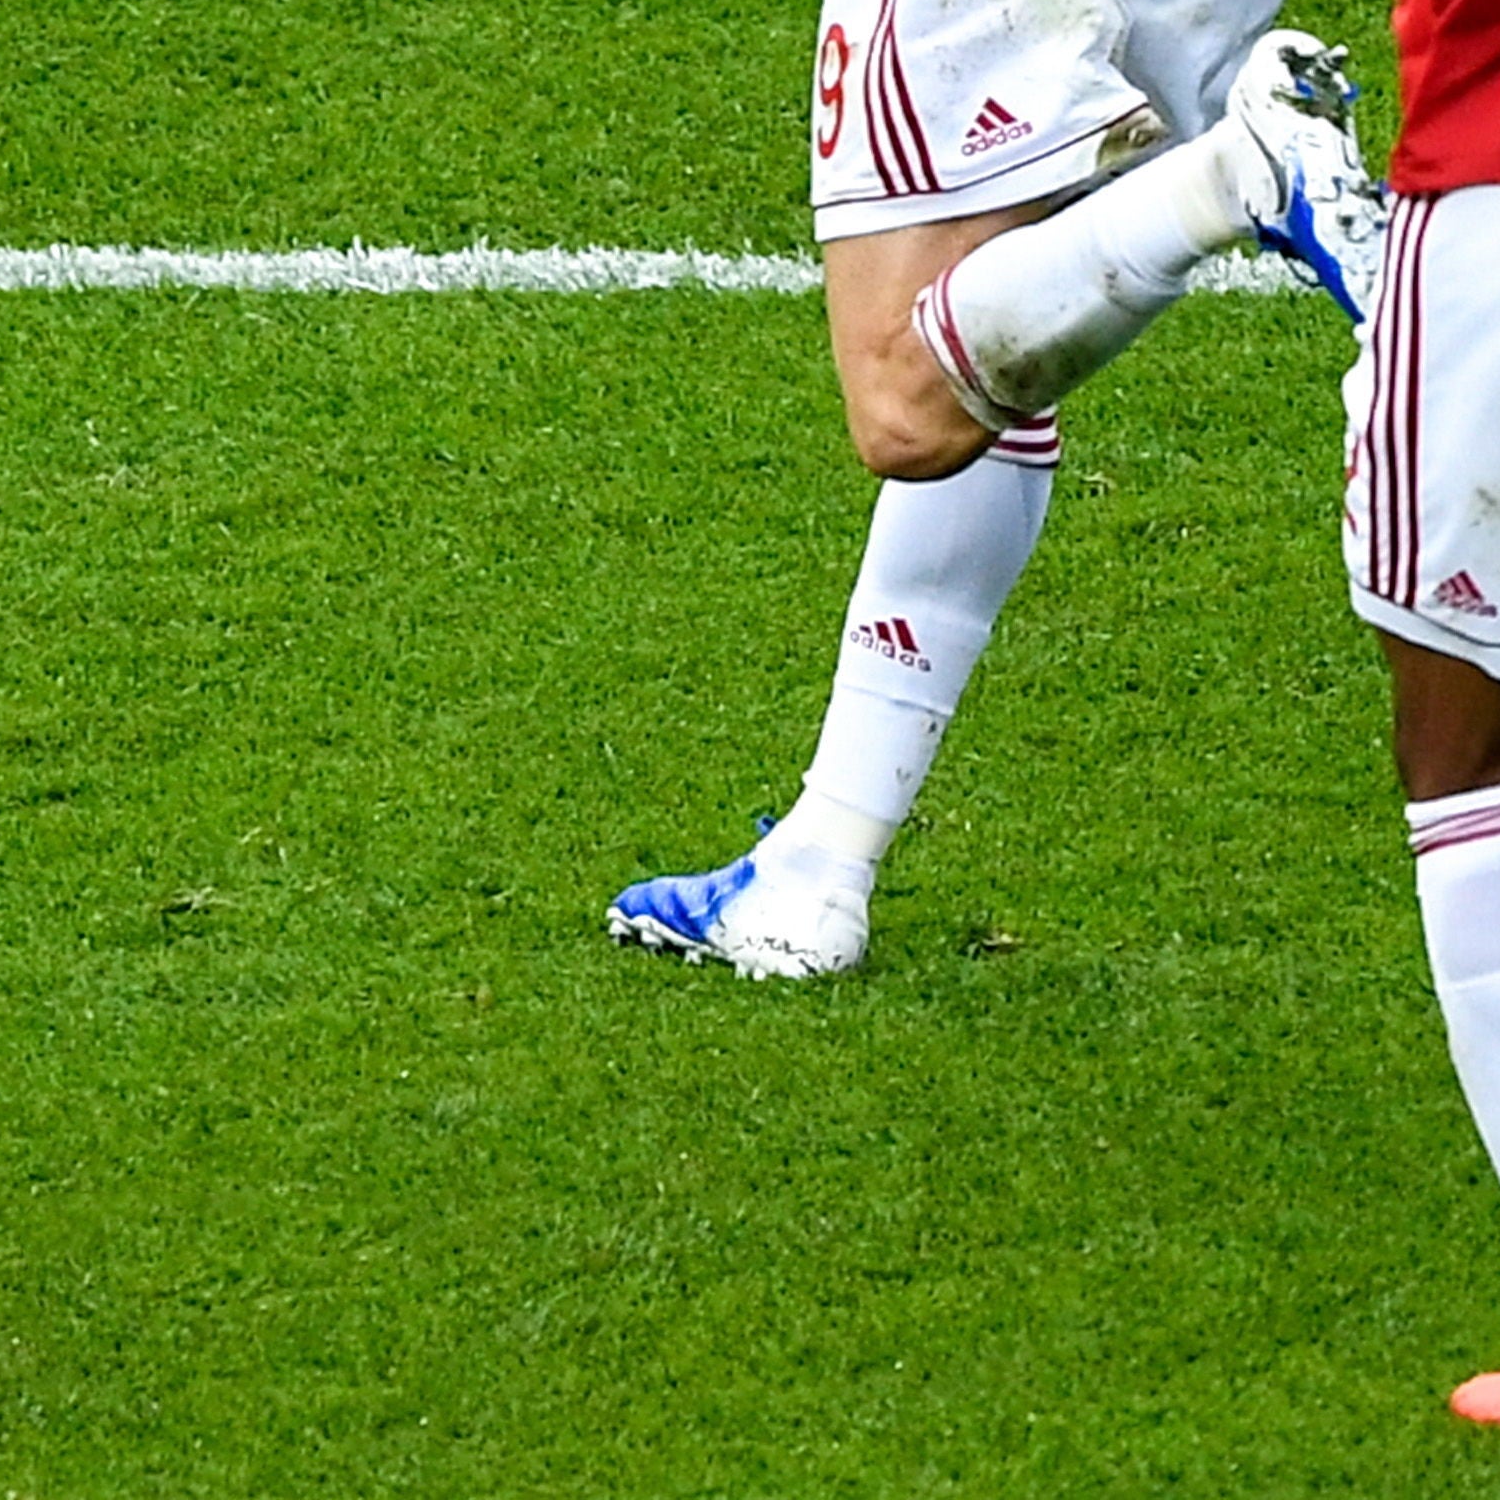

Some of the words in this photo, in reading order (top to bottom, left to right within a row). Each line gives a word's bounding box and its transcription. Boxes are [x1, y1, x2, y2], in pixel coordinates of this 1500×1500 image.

[818, 22, 850, 159] 9
[961, 121, 1033, 157] adidas
[850, 631, 931, 672] adidas
